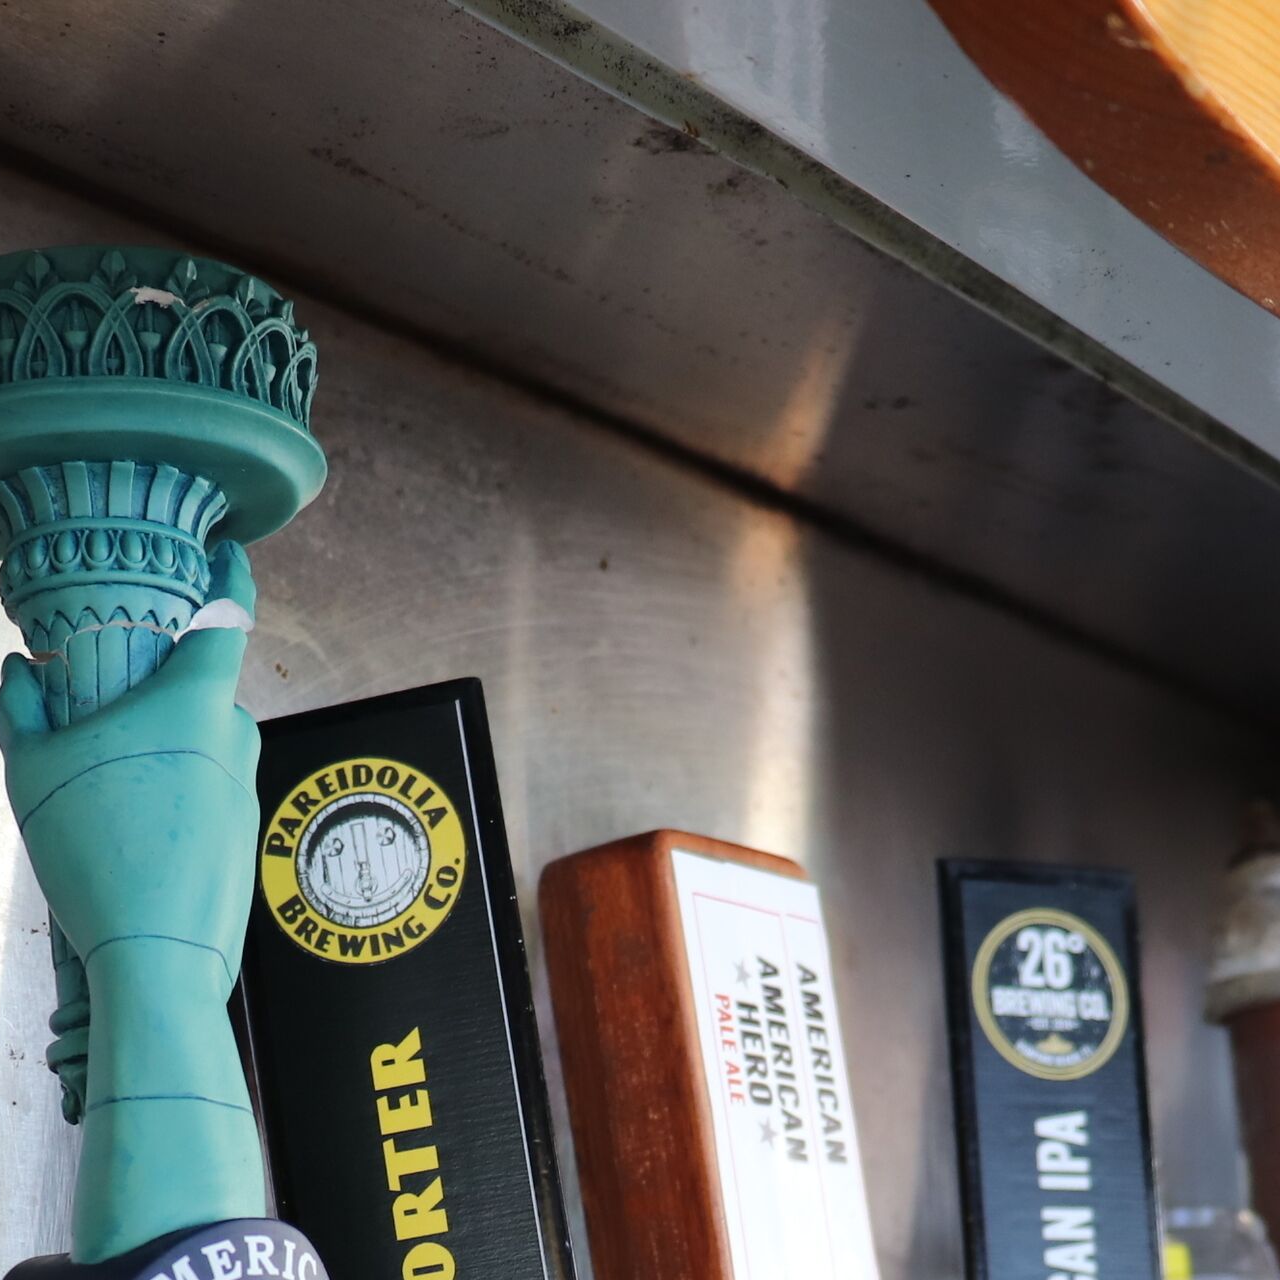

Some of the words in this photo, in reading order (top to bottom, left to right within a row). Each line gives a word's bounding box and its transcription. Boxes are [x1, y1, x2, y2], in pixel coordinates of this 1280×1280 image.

[265, 764, 448, 859] PAREIDOLIA
[277, 895, 427, 958] BREWING
[423, 857, 461, 910] CO.
[1015, 927, 1087, 990] 26°
[714, 993, 737, 1054] PALE
[736, 1000, 773, 1108] HERO
[756, 955, 809, 1163] AMERICAN
[796, 962, 848, 1165] AMERICAN
[725, 1060, 746, 1106] ALE
[1033, 1110, 1093, 1191] IPA
